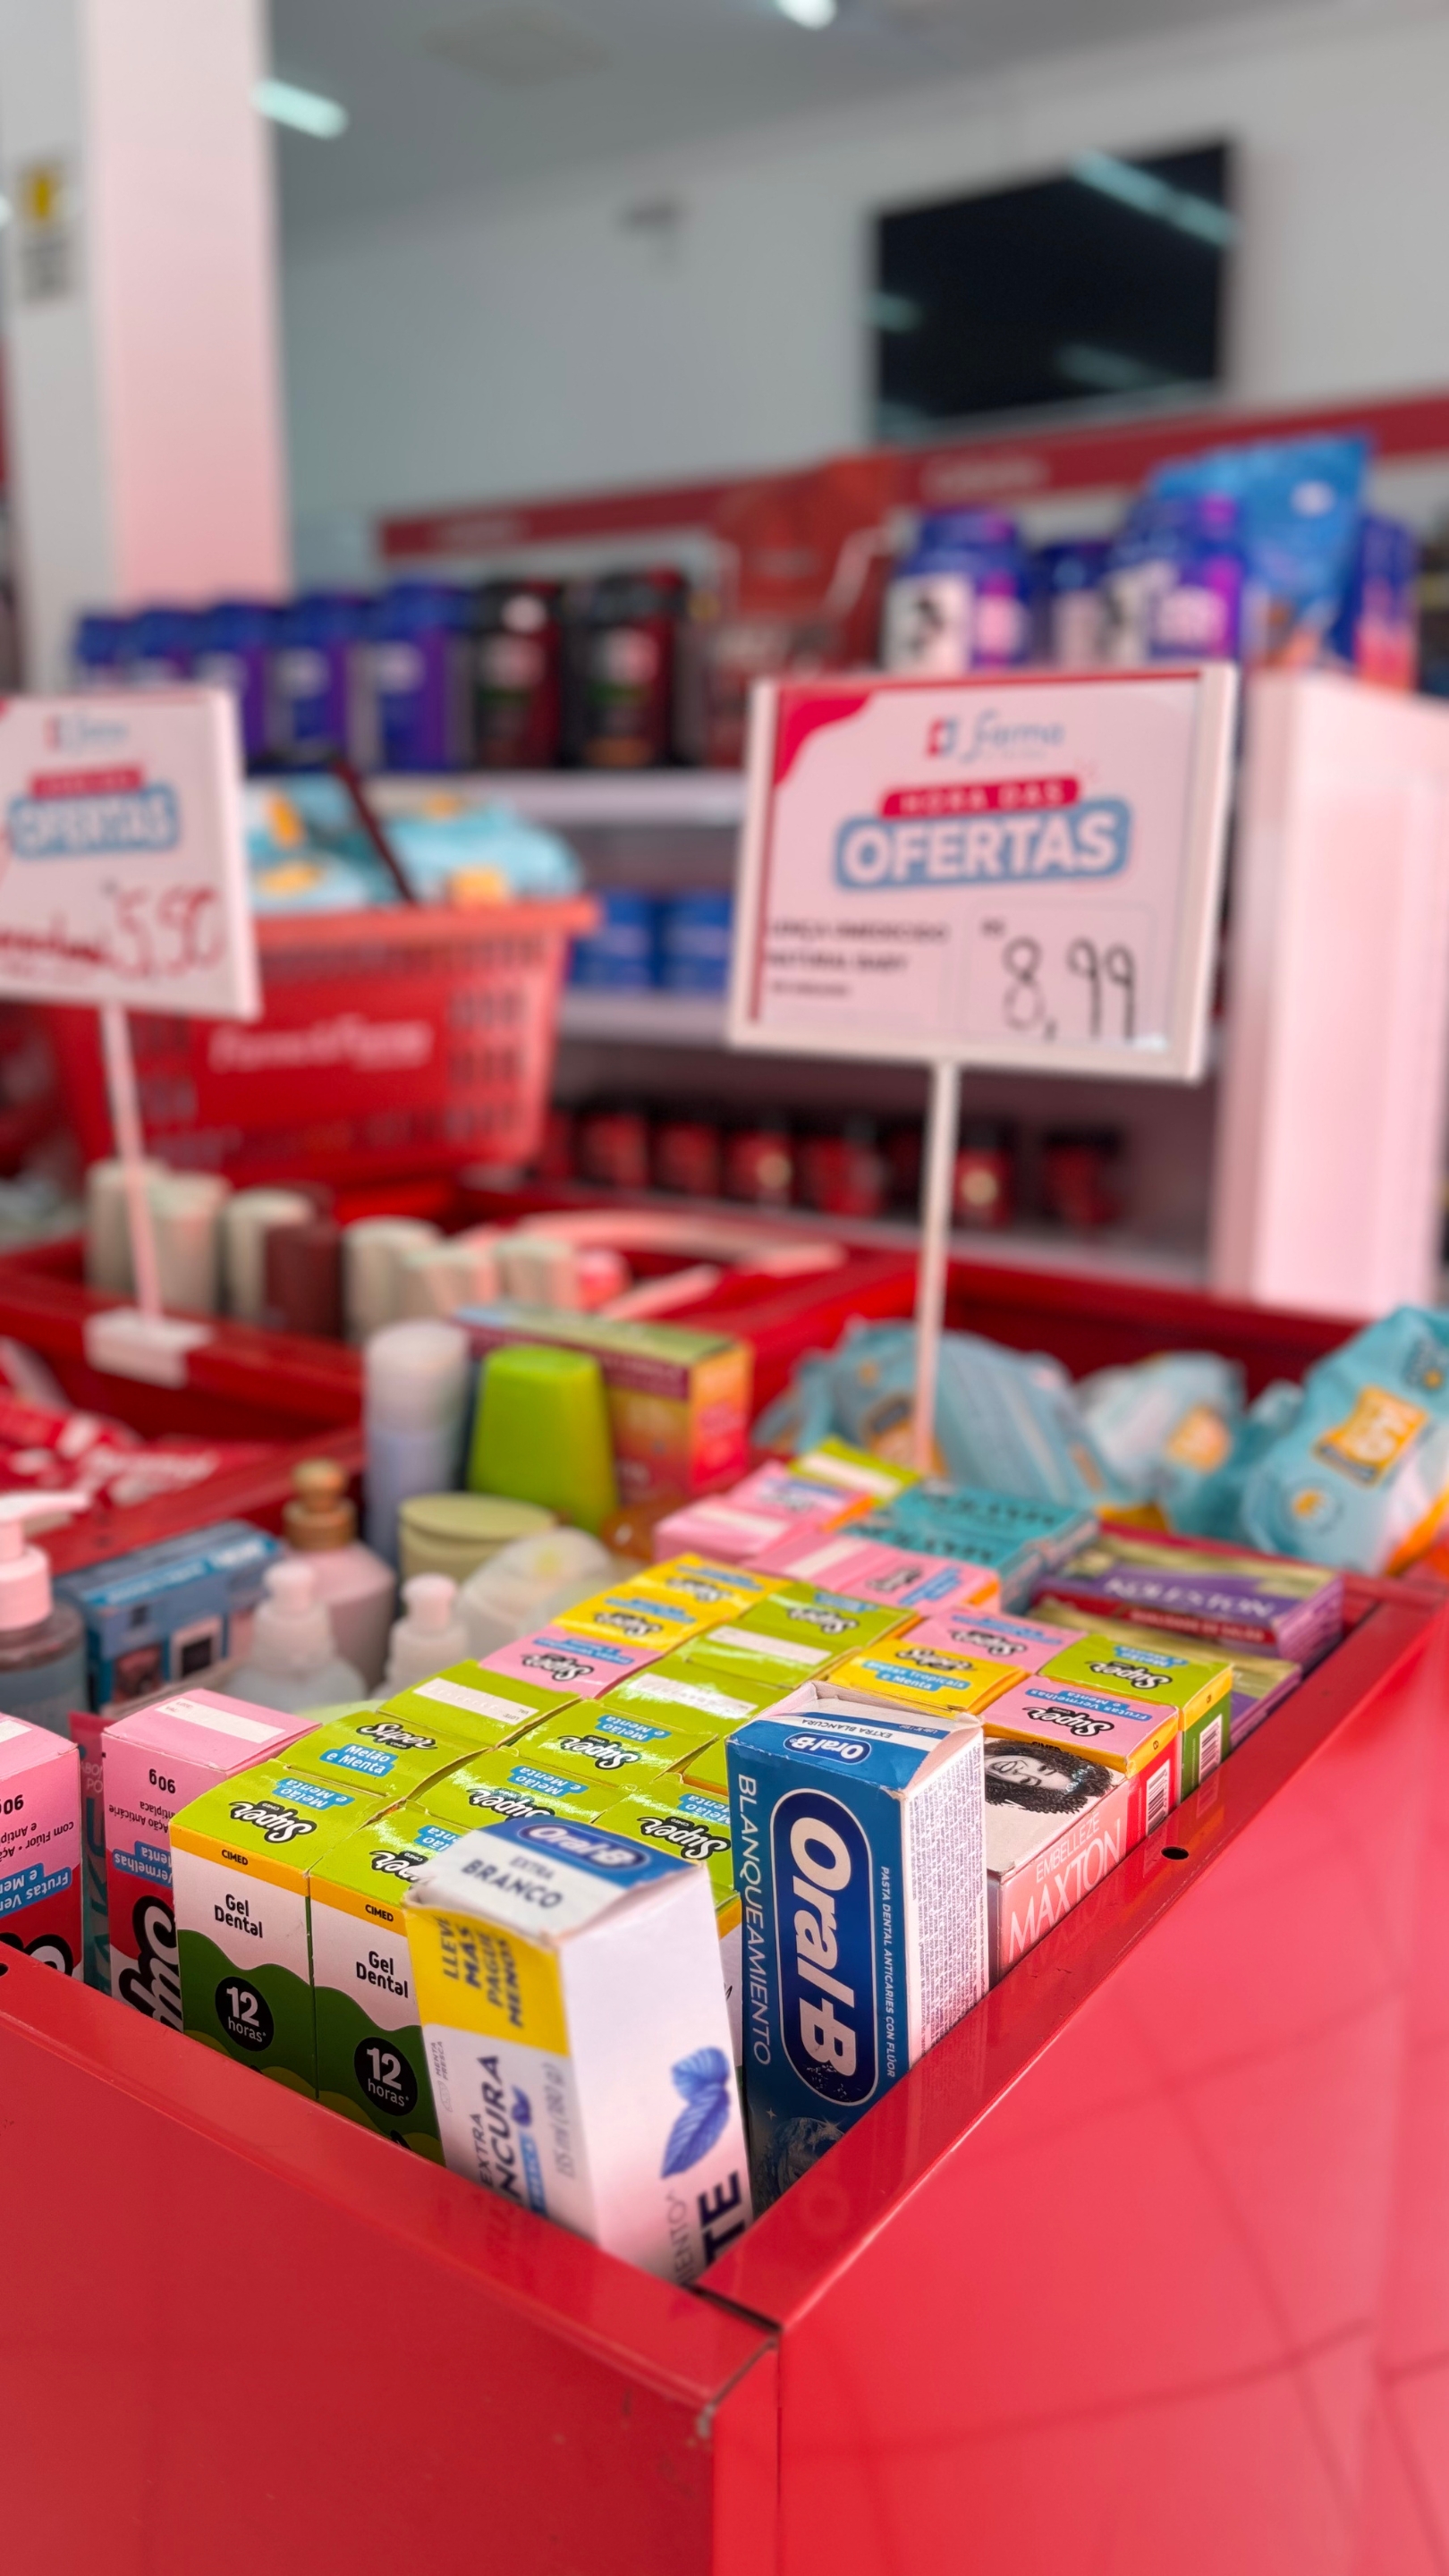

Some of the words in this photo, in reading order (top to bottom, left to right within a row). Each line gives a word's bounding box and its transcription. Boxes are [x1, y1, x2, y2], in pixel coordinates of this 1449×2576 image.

[899, 791, 989, 814] HORA
[997, 781, 1065, 808] DAS
[842, 810, 1117, 884] OFERTAS
[1003, 936, 1135, 1041] 8,99
[894, 1675, 932, 1690] Menta
[1086, 1661, 1171, 1690] Super
[1030, 1690, 1100, 1711] Vermelhas
[1066, 1691, 1110, 1705] Menta
[606, 1716, 652, 1733] Menta
[801, 1718, 858, 1733] BLANCURA
[1022, 1707, 1114, 1736] Super
[1111, 1707, 1148, 1721] Frutas
[359, 1724, 437, 1749] Super
[602, 1723, 648, 1741] Melão
[859, 1728, 894, 1739] EXTRA
[345, 1745, 392, 1763] Melão
[558, 1735, 640, 1769] Super
[791, 1735, 865, 1760] Oral-B
[338, 1756, 387, 1775] Menta
[519, 1767, 569, 1787] Menta
[148, 1768, 176, 1793] 90g
[285, 1779, 335, 1800] Menta
[516, 1775, 564, 1795] Melão
[280, 1787, 328, 1808] Melão
[108, 1803, 146, 1826] Anticárie
[148, 1818, 169, 1834] Ação
[229, 1801, 313, 1843] Super
[25, 1832, 51, 1849] Flúor
[55, 1820, 74, 1837] com
[638, 1818, 728, 1859] Super
[222, 1849, 249, 1866] CIMED
[528, 1826, 637, 1866] Oral-B
[1036, 1811, 1100, 1884] EMBELLEZE
[508, 1855, 555, 1880] EXTRA
[26, 1872, 69, 1900] Frutas
[461, 1859, 564, 1909] BRANCO
[880, 1866, 891, 1902] PASTA
[1008, 1817, 1122, 1963] MAXTON
[225, 1894, 250, 1918] Gel
[365, 1903, 394, 1922] CIMED
[214, 1904, 264, 1939] Dental
[737, 1774, 771, 2066] BLANQUEAMIENTO
[882, 1903, 893, 1945] DENTAL
[790, 1816, 857, 2078] Oral-B
[368, 1950, 394, 1976] Gel
[355, 1961, 410, 1999] Dental
[884, 1948, 895, 2013] ANTICARIES
[226, 1986, 260, 2027] 12
[886, 2015, 895, 2037] CON
[366, 2047, 402, 2090] 12
[430, 2042, 443, 2077] MENTA
[437, 2040, 449, 2081] FRESCA
[476, 2055, 524, 2199] NCURA
[470, 2113, 493, 2188] EXTRA
